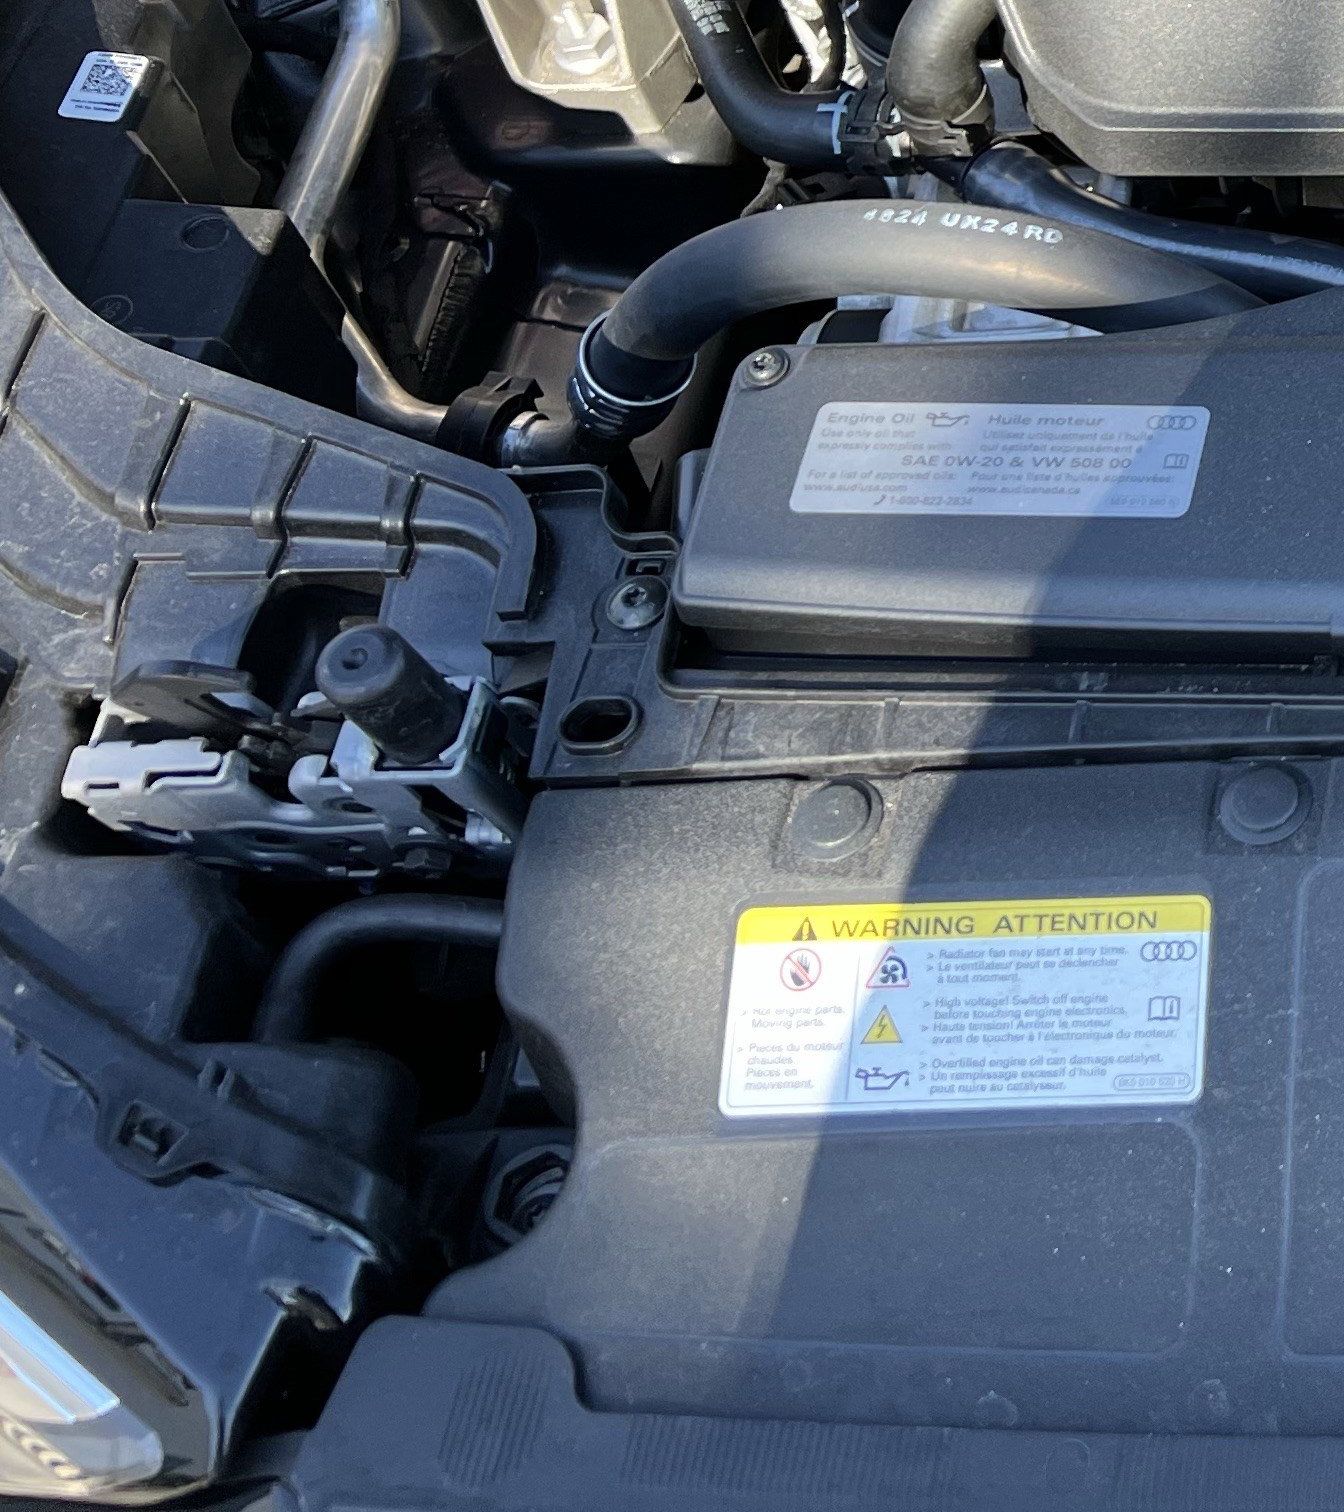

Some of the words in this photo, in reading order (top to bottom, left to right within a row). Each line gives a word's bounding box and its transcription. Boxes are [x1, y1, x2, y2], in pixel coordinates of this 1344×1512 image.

[827, 412, 886, 425] Engine
[891, 413, 915, 423] Oil
[988, 414, 1033, 426] Huile
[1037, 415, 1105, 426] moteur
[901, 455, 940, 467] SAE
[944, 455, 1004, 468] 0W-20
[1009, 457, 1025, 468] &
[1032, 457, 1065, 468] VW
[1070, 457, 1103, 469] 508
[1109, 457, 1132, 469] 00
[808, 469, 828, 479] For
[832, 915, 976, 938] WARNING
[992, 910, 1157, 935] ATTENTION
[939, 948, 985, 959] Radiator
[989, 948, 1005, 958] fan
[1009, 948, 1033, 959] may
[1036, 947, 1060, 957] start
[1077, 947, 1097, 957] any
[938, 962, 951, 971] Le
[955, 961, 1013, 970] ventilateur
[1016, 960, 1040, 971] peut
[935, 996, 961, 1009] High
[1012, 994, 1050, 1005] Switch
[1052, 993, 1068, 1004] off
[1070, 993, 1109, 1005] engine
[934, 1009, 969, 1019] before
[973, 1009, 1021, 1021] touching
[1024, 1007, 1062, 1019] engine
[752, 1019, 793, 1029] Moving
[933, 1021, 965, 1032] Haute
[1072, 1018, 1112, 1028] moteur
[932, 1034, 962, 1044] avant
[966, 1033, 979, 1043] de
[982, 1033, 1025, 1043] toucher
[1116, 1029, 1131, 1039] du
[804, 1042, 843, 1050] moteur
[932, 1057, 986, 1068] Overfilled
[989, 1056, 1027, 1069] engine
[1029, 1055, 1043, 1065] oil
[1047, 1056, 1066, 1065] can
[1069, 1054, 1114, 1066] damage
[784, 1068, 797, 1076] en
[930, 1071, 947, 1081] Un
[951, 1070, 1018, 1081] remplissage
[929, 1084, 955, 1096] peut
[958, 1083, 986, 1092] nuire
[989, 1083, 1003, 1091] au
